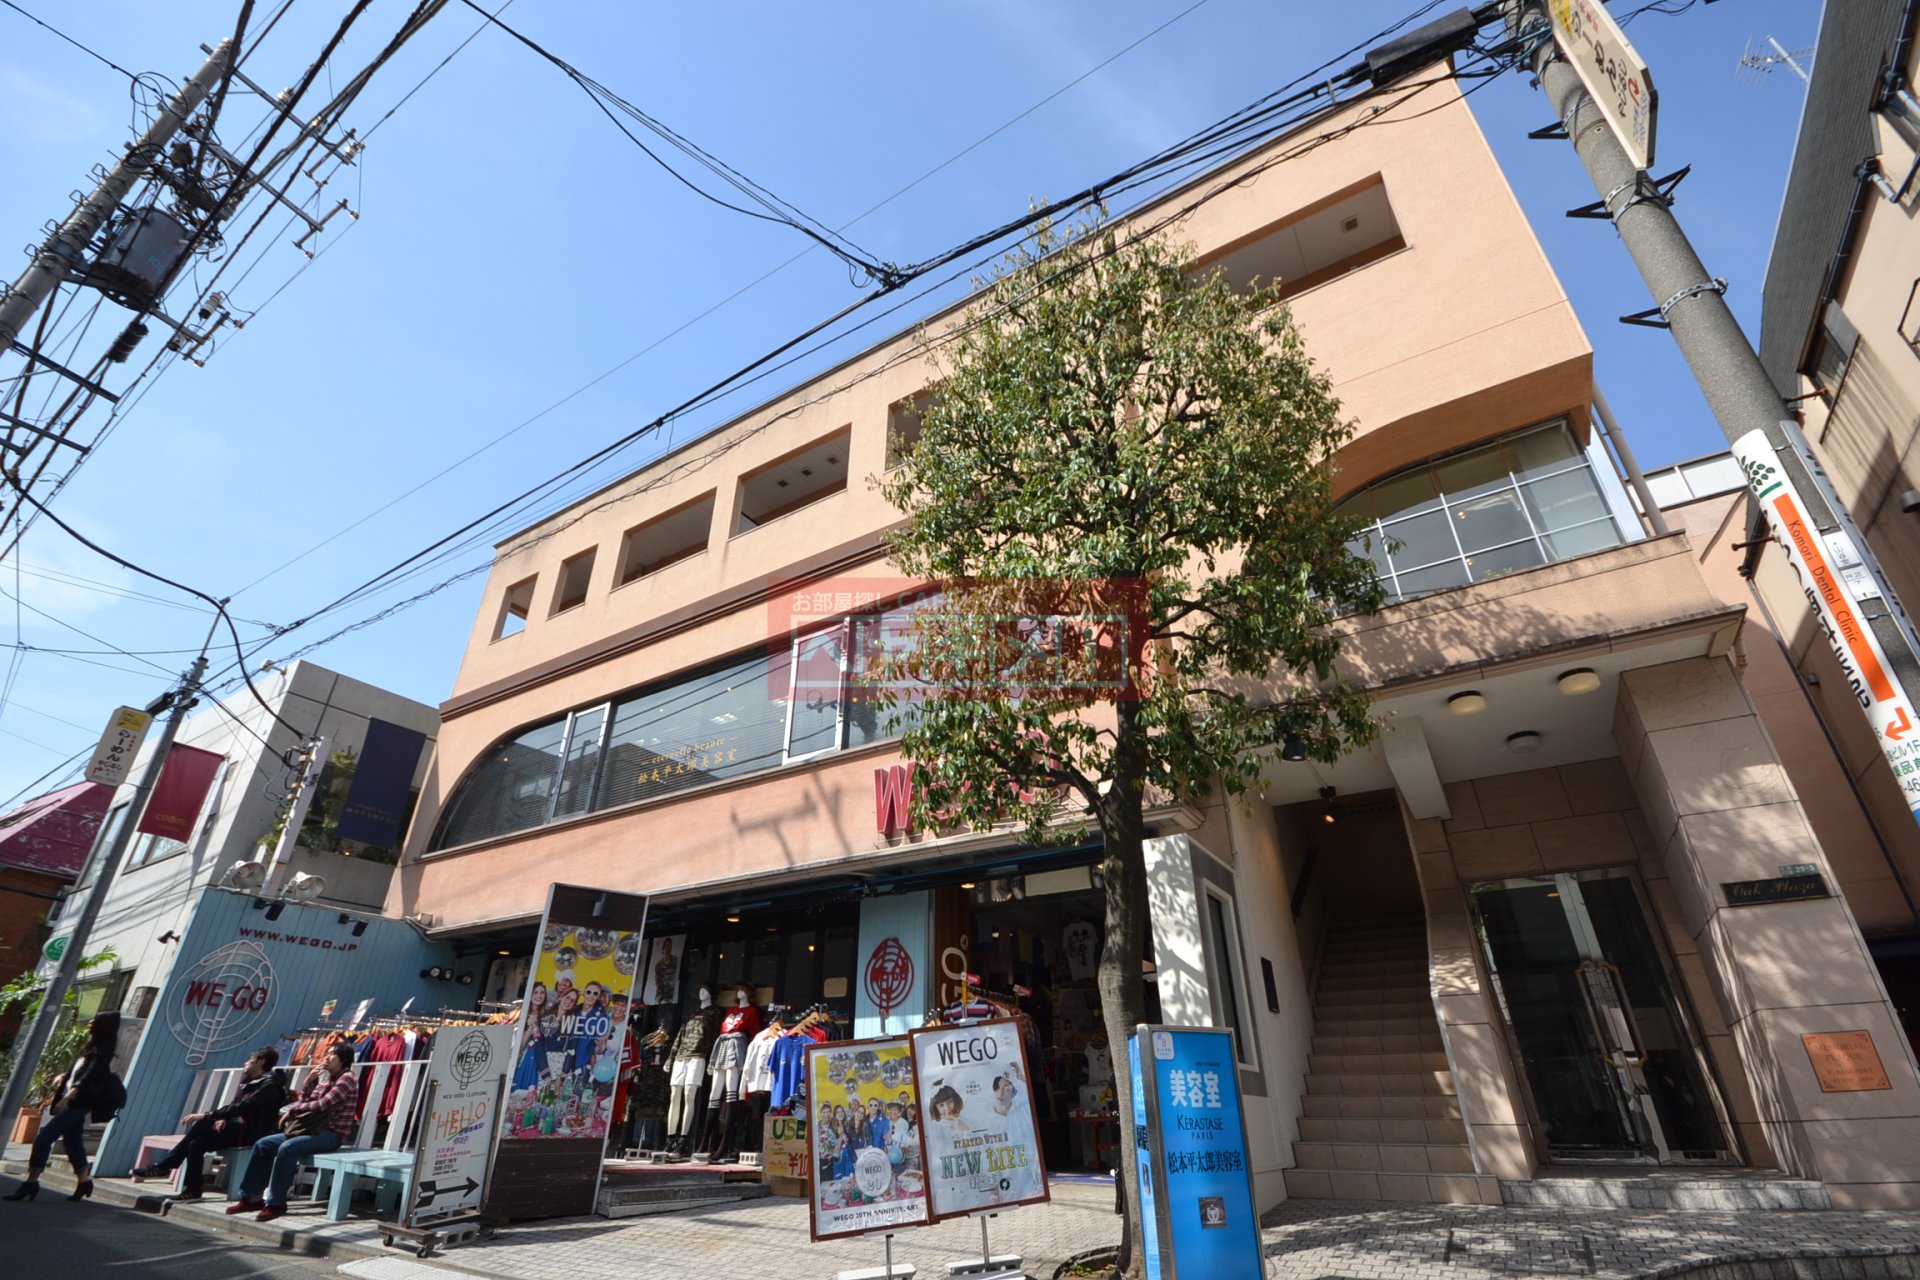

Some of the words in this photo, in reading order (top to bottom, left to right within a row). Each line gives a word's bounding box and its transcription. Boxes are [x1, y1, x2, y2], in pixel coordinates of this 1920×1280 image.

[1788, 519, 1819, 563] Komori
[1812, 565, 1841, 606] Dental
[1835, 610, 1859, 644] Clinic
[1733, 883, 1762, 898] Oak
[1770, 880, 1816, 895] Plaza
[239, 927, 358, 951] WWW.WEGO.JP
[560, 1015, 609, 1036] WEGO
[937, 1036, 998, 1066] WEGO
[1169, 1069, 1222, 1108] 美容室
[953, 1136, 984, 1149] STARTED
[1003, 1132, 1009, 1142] A
[1191, 1131, 1214, 1140] PARIS
[865, 1165, 882, 1175] WEGO
[940, 1150, 981, 1179] NEW
[985, 1144, 1028, 1172] LIFE
[1168, 1149, 1243, 1175] 松本平太郎美容室
[833, 1213, 854, 1221] WEGO
[856, 1210, 872, 1218] 20TH
